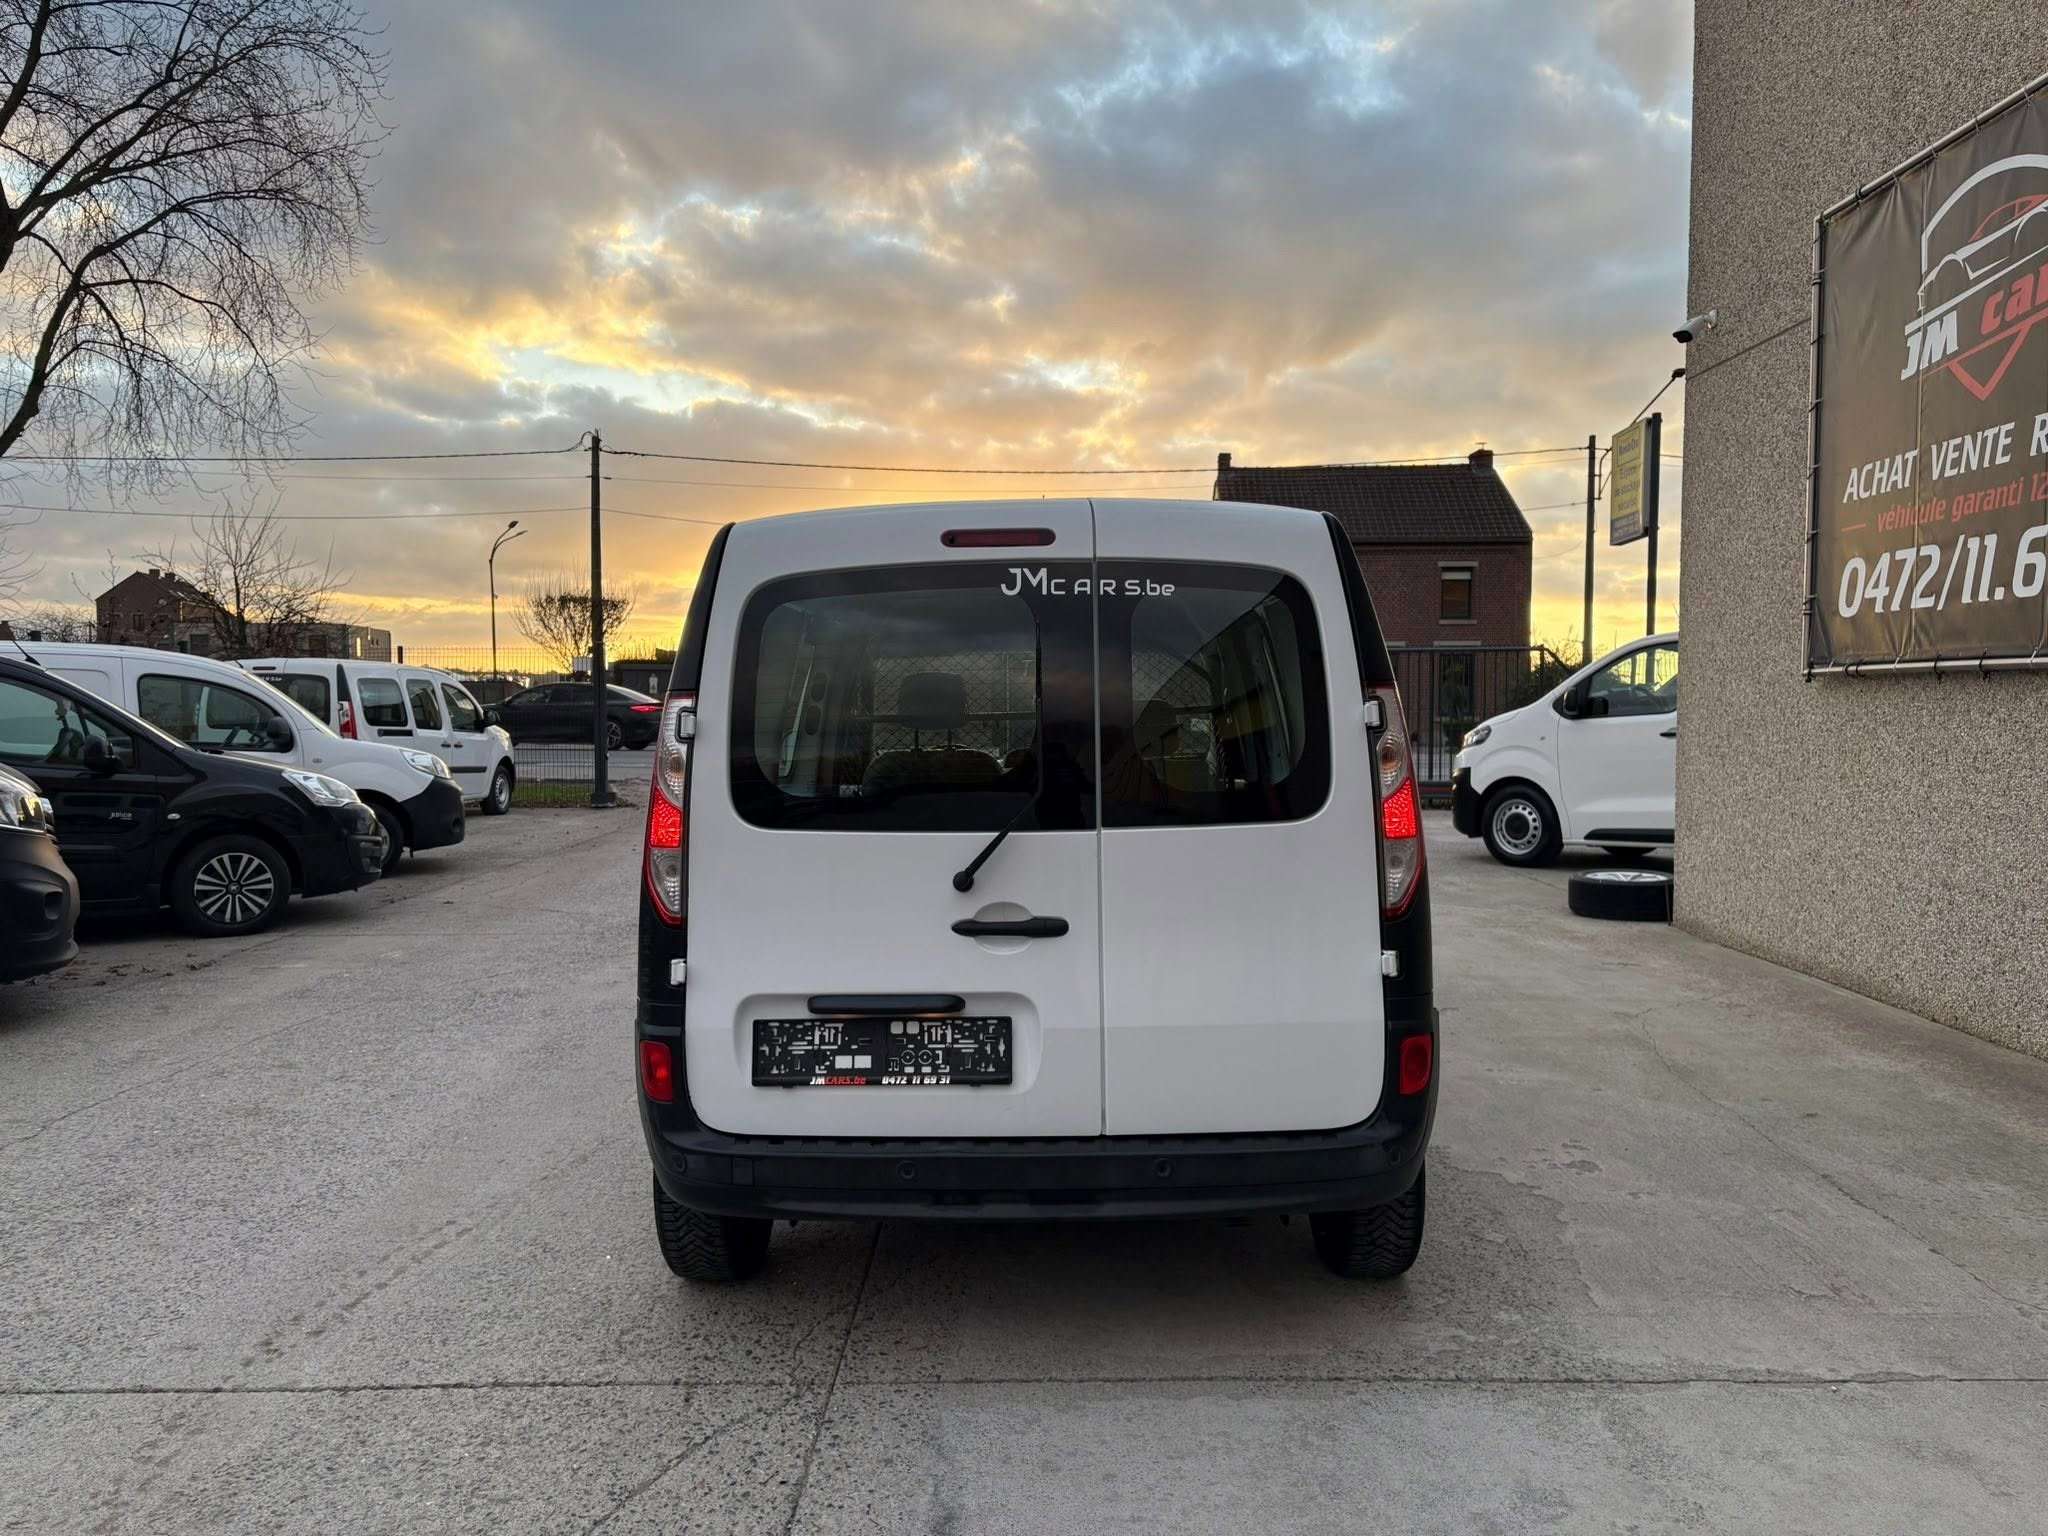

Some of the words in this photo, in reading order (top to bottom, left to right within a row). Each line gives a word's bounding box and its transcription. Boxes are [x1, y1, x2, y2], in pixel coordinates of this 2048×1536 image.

[1900, 310, 1959, 381] JM
[1843, 448, 1919, 504] ACHAT
[1930, 421, 2016, 481] VENTE
[1877, 496, 1947, 533] véhicule
[1951, 477, 2025, 523] garanti
